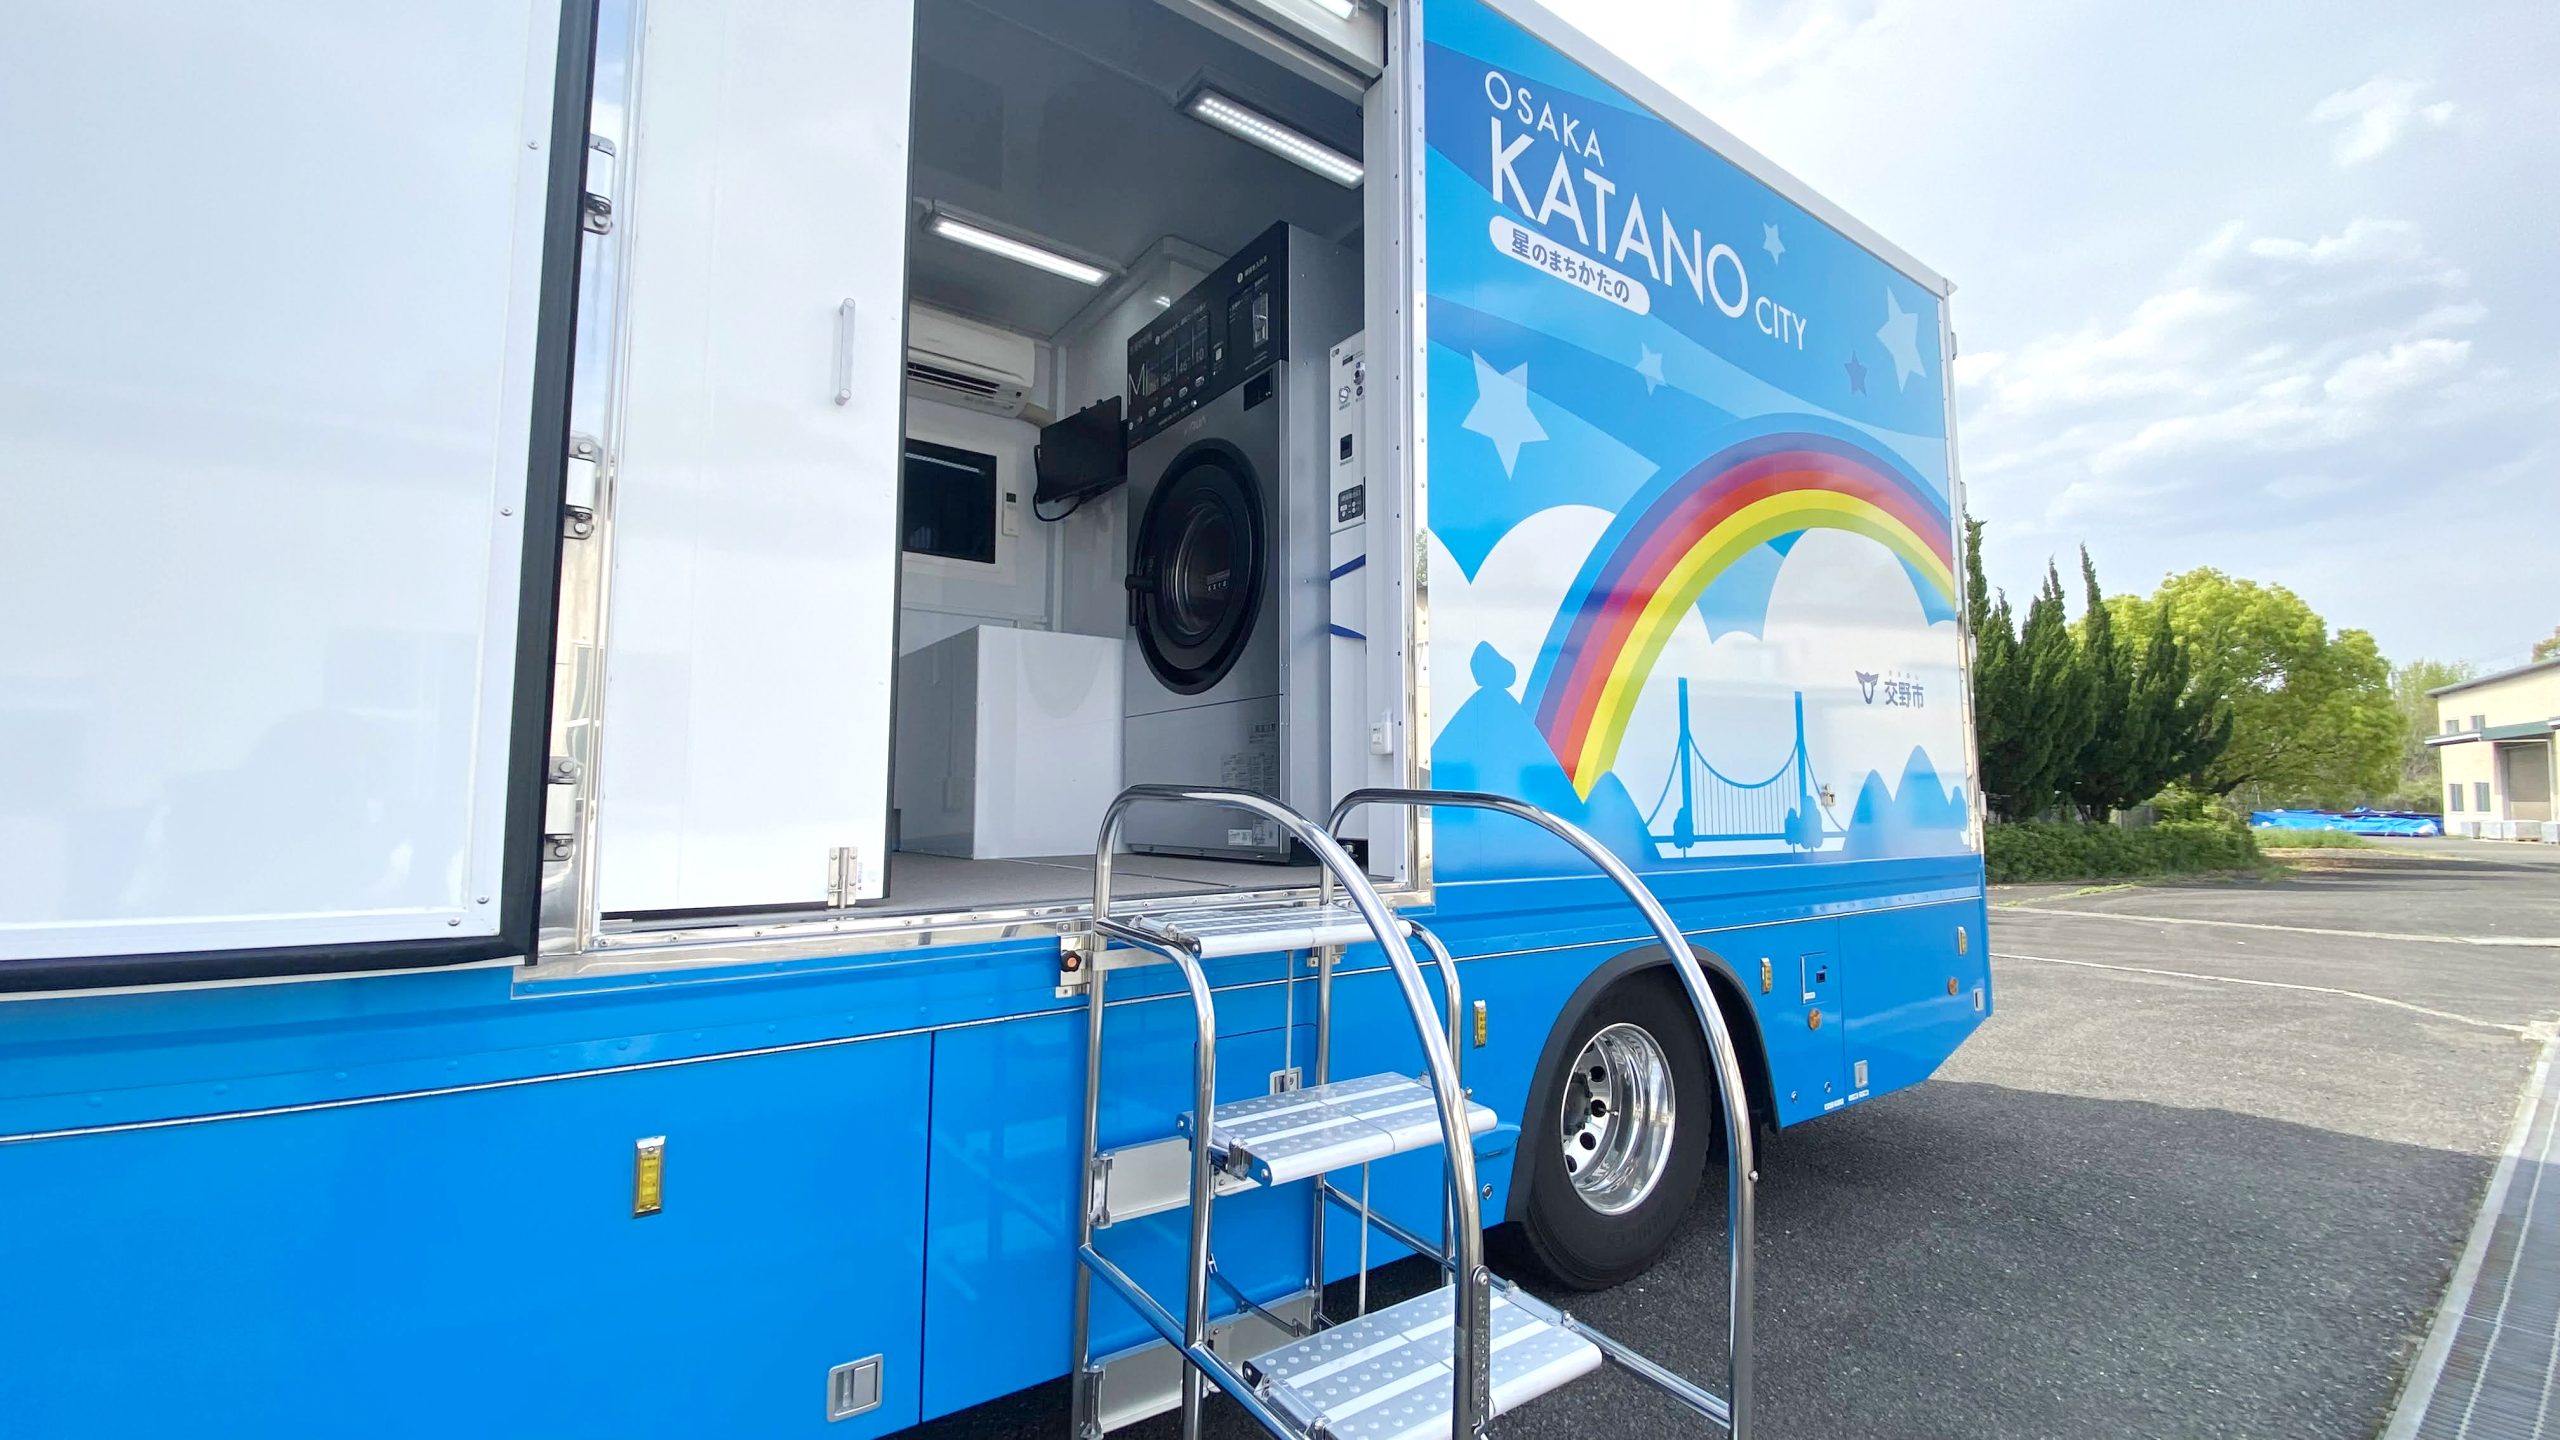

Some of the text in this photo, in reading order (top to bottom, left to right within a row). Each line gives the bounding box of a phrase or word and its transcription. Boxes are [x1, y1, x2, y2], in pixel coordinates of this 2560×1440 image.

[1484, 70, 1605, 167] OSAKA
[1491, 116, 1807, 351] KATANO CITY
[1511, 227, 1630, 303] 星のまちかたの
[1884, 680, 1924, 709] 交野市
